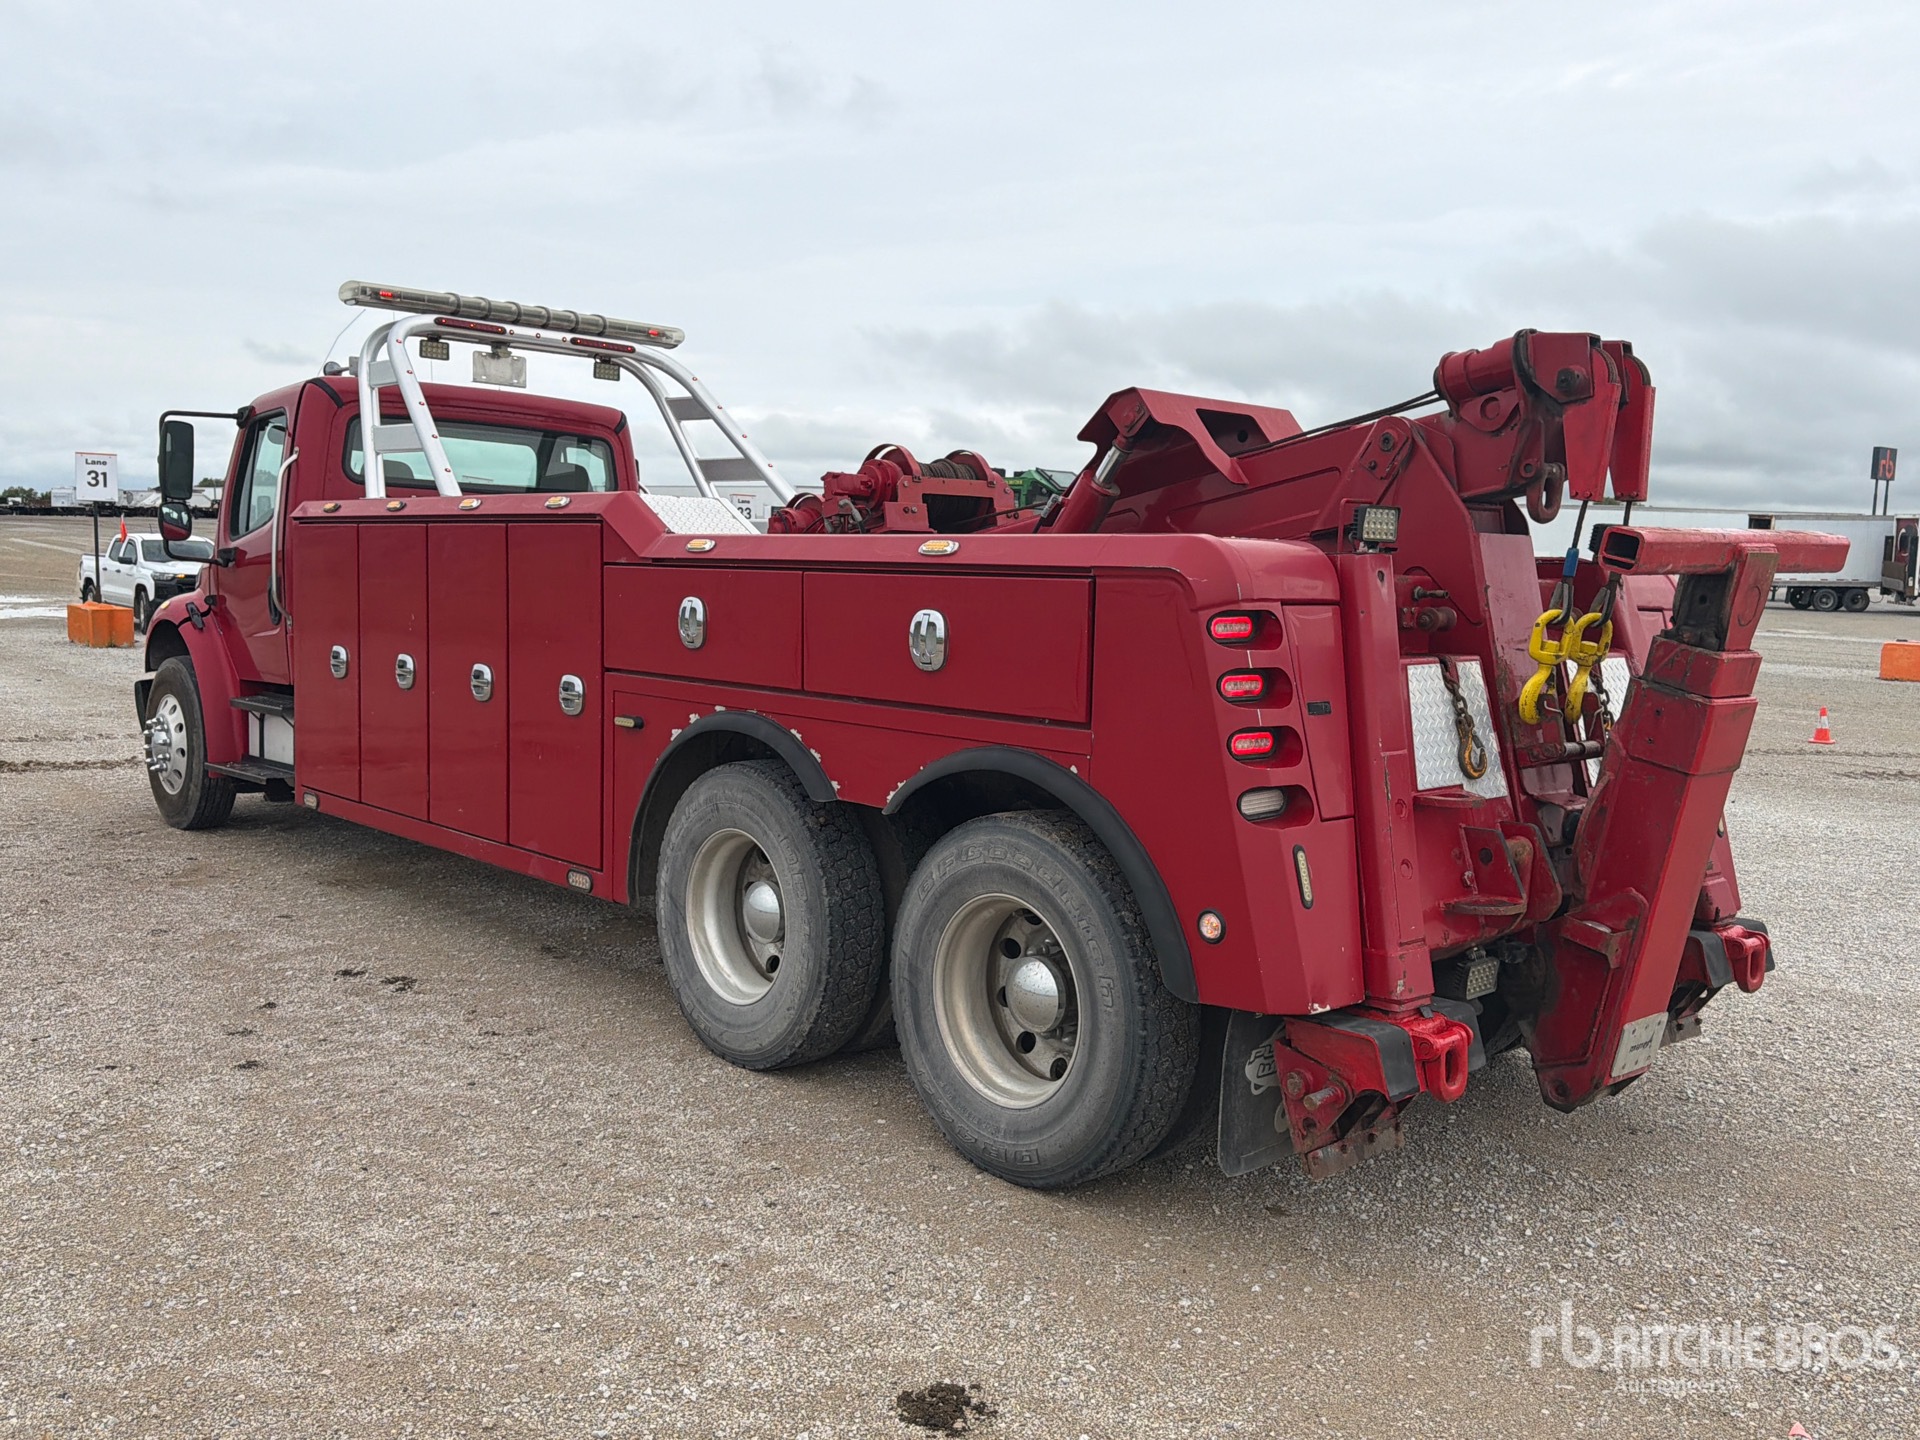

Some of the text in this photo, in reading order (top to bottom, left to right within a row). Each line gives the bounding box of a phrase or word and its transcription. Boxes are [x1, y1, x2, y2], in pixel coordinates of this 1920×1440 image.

[85, 458, 107, 466] Lane
[1879, 450, 1894, 478] rb
[87, 470, 107, 488] 31
